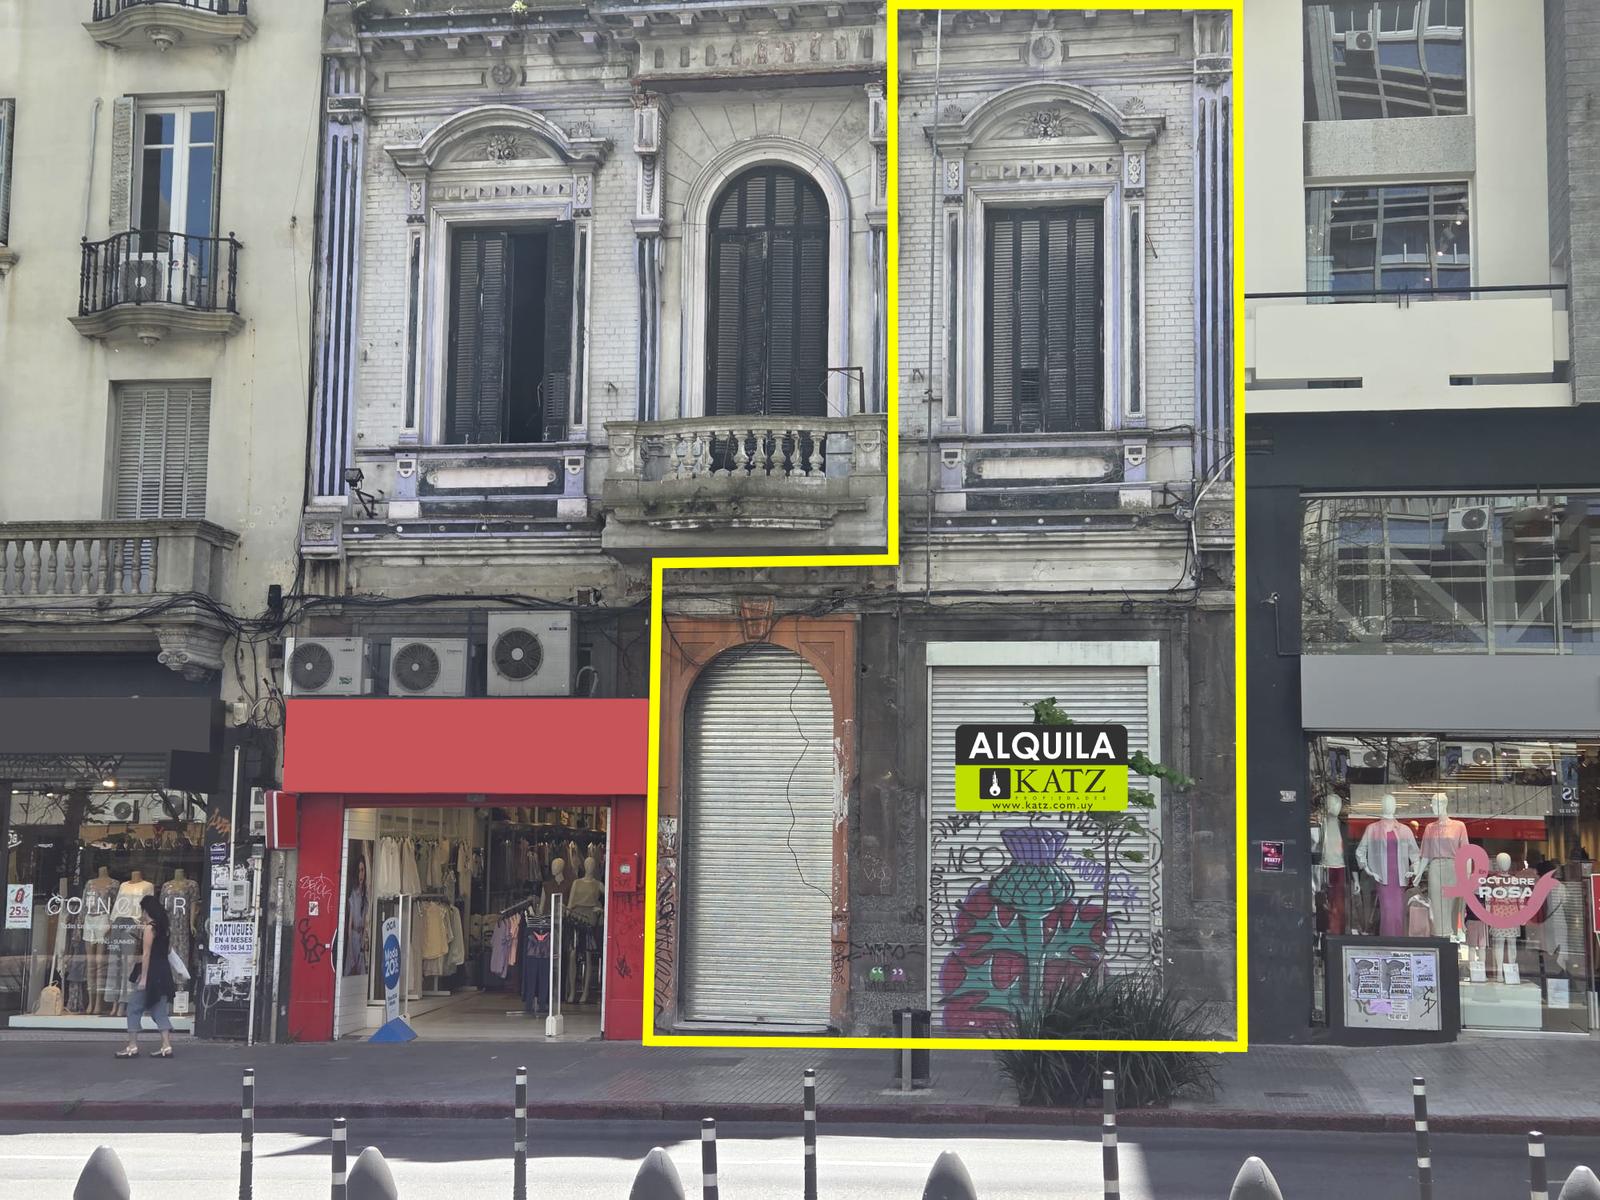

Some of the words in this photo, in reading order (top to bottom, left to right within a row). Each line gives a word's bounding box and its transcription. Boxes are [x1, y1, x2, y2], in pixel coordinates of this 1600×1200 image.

[968, 731, 1116, 761] ALQUILA
[1013, 768, 1107, 794] KATZ
[992, 801, 1094, 811] www.katz.com.uy
[1478, 876, 1536, 886] OCTUBRE
[1478, 886, 1533, 901] ROSA
[9, 905, 30, 917] 25%
[214, 923, 254, 936] PORTUGUES
[386, 920, 397, 932] OCA
[214, 936, 224, 944] EN
[225, 936, 230, 944] 4
[230, 936, 254, 944] MESES
